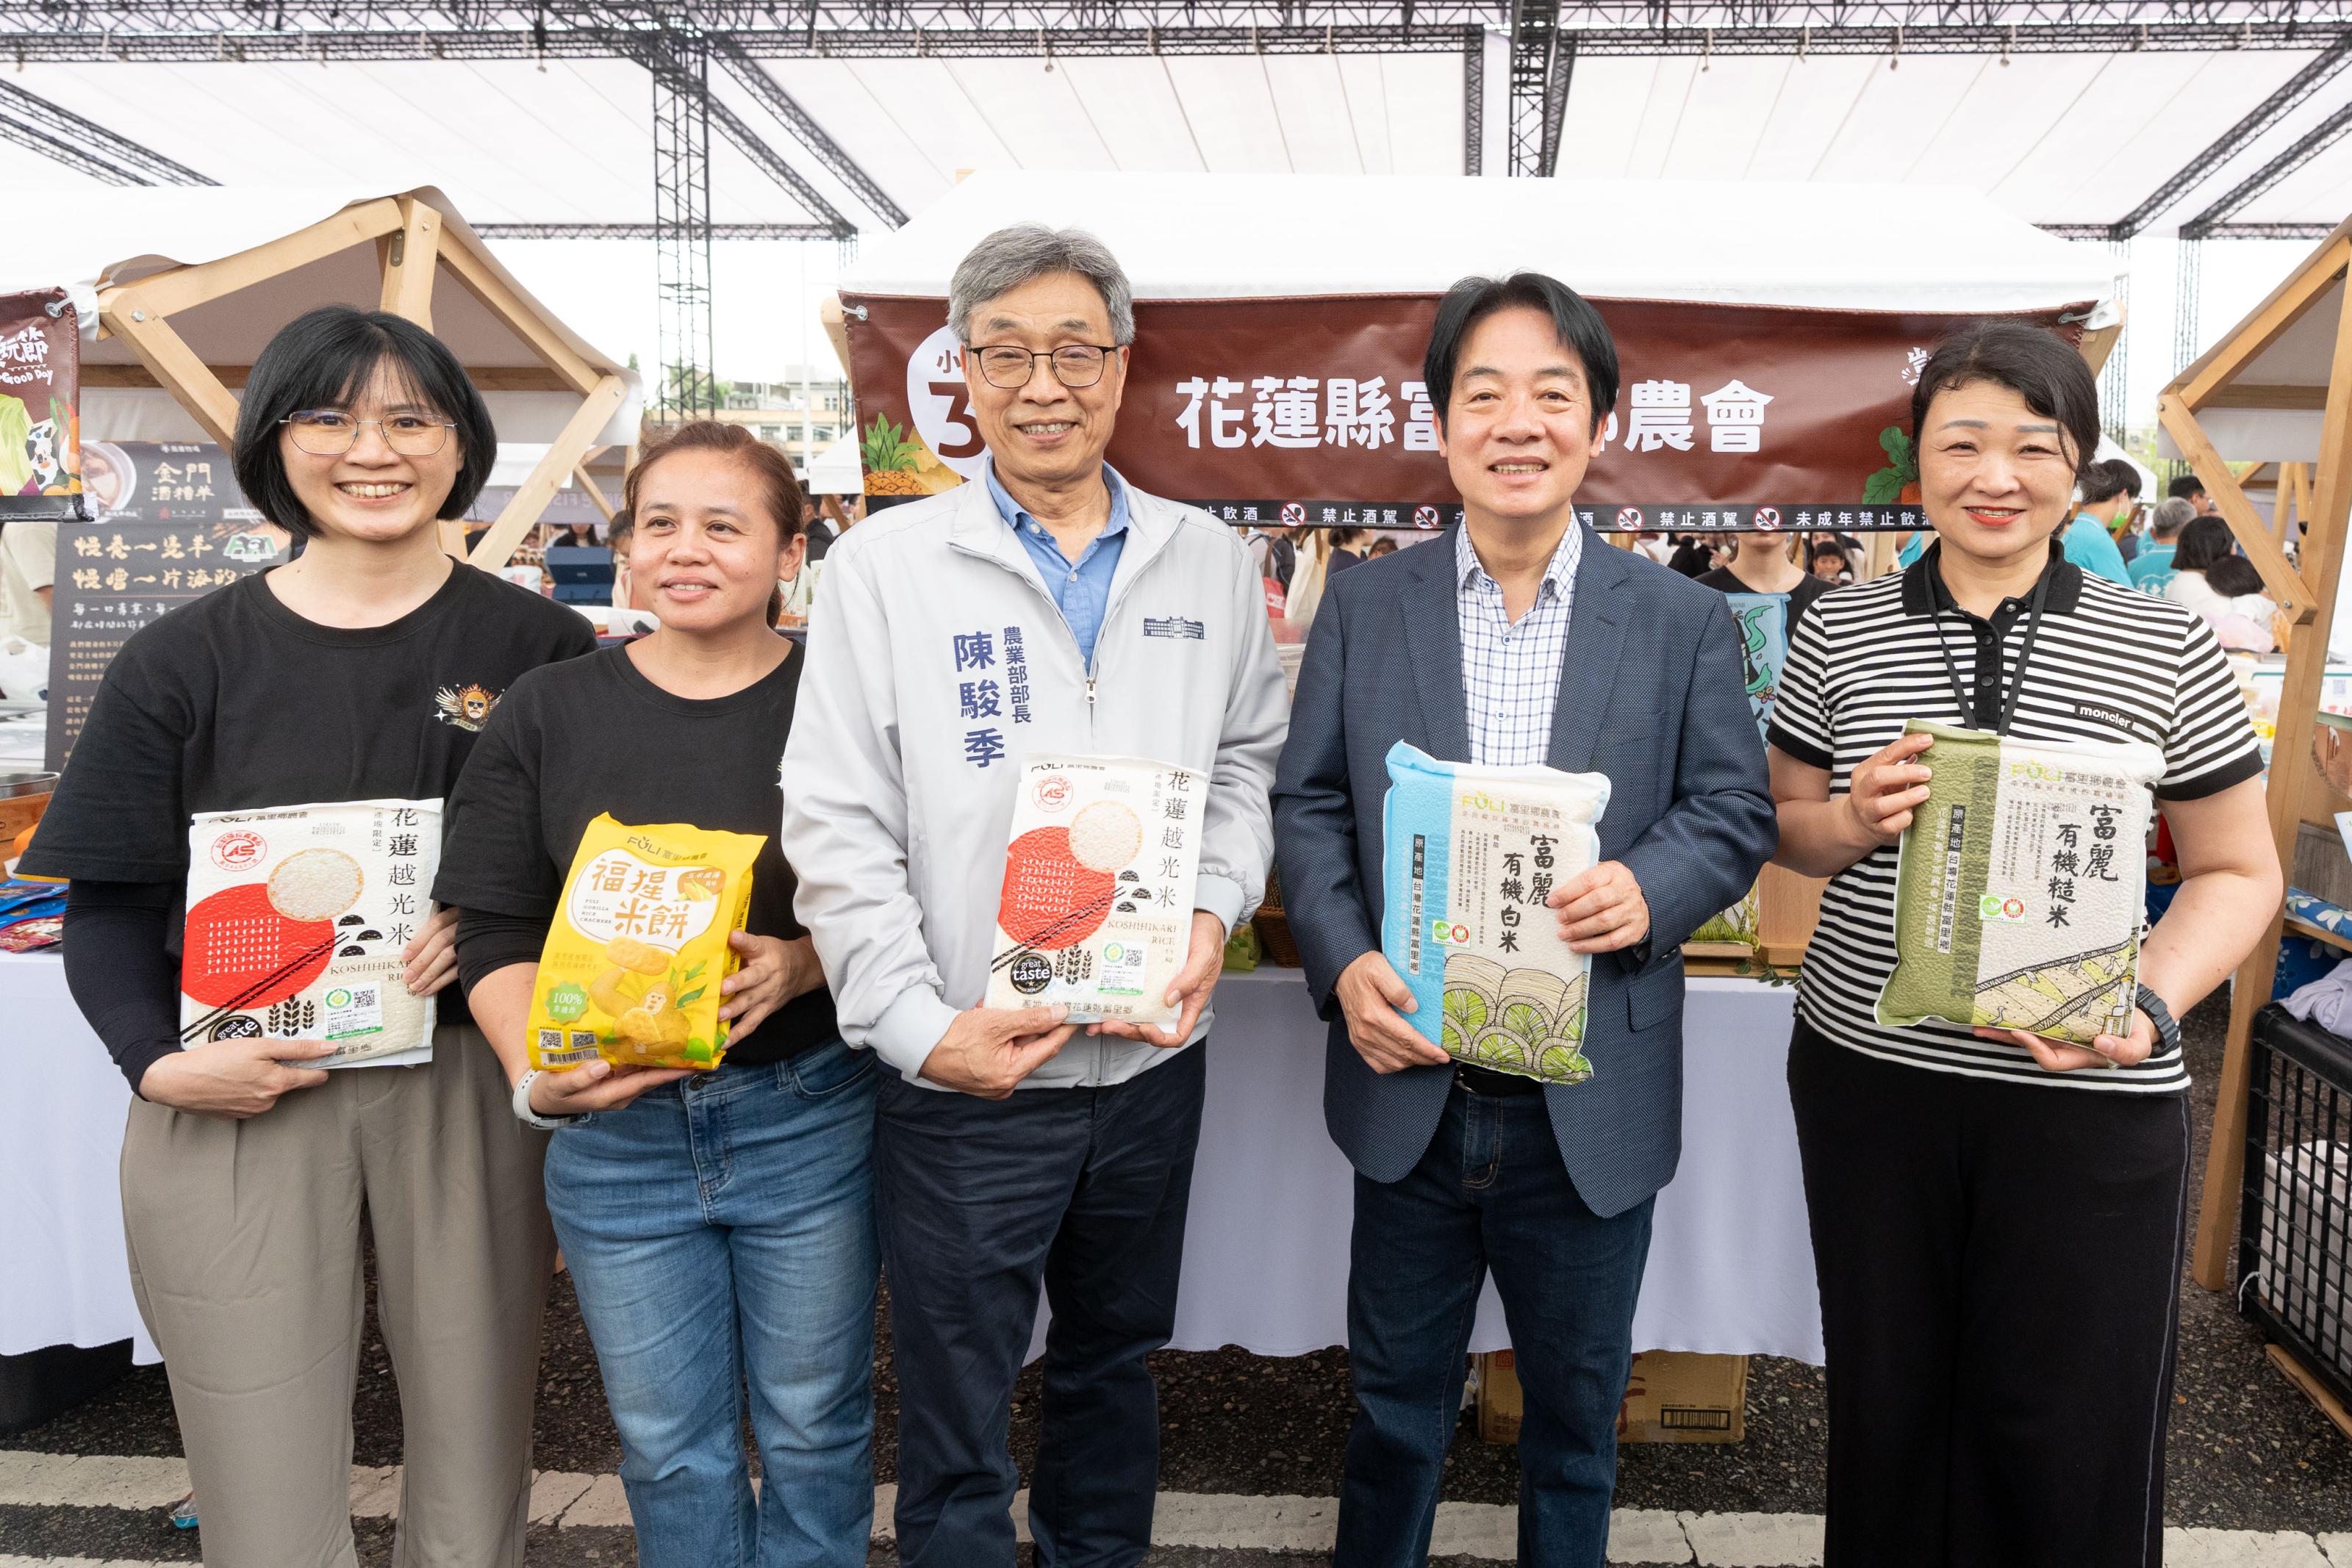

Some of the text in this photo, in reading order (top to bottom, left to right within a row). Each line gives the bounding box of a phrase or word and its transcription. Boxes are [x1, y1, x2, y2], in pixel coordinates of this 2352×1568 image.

[0, 326, 49, 364] 玩節
[1175, 375, 1775, 453] 花蓮縣富農會
[154, 461, 212, 484] 金門
[1322, 508, 1397, 524] 禁止酒駕
[1660, 511, 1738, 527] 禁止酒駕
[72, 567, 257, 591] 慢嚐一片海的
[1003, 626, 1031, 724] 農業部部長
[953, 630, 1005, 769] 陳駿季
[2079, 706, 2132, 728] moncler
[2064, 771, 2127, 789] 富里鄉農會
[1155, 772, 1191, 909] 花蓮越光米
[2082, 804, 2123, 882] 富麗
[386, 808, 420, 946] 花蓮越光米
[591, 858, 667, 901] 福猩
[1527, 833, 1559, 908] 富麗
[1939, 809, 1963, 949] 原產地 台灣花蓮縣富里鄉
[2046, 823, 2082, 929] 有機糙米
[614, 898, 689, 939] 米餅
[1409, 838, 1424, 972] 原產地 台灣花蓮縣富里鄉
[1498, 852, 1524, 954] 有機白米
[1108, 920, 1177, 932] KOSHIHIKARI
[1152, 936, 1175, 946] RICE
[330, 960, 412, 975] KOSHIHIKAR
[388, 973, 404, 982] RI
[1014, 968, 1050, 981] taste
[1021, 960, 1041, 970] great
[553, 993, 583, 1005] 100%
[218, 1021, 240, 1040] great
[224, 1021, 258, 1040] ste
